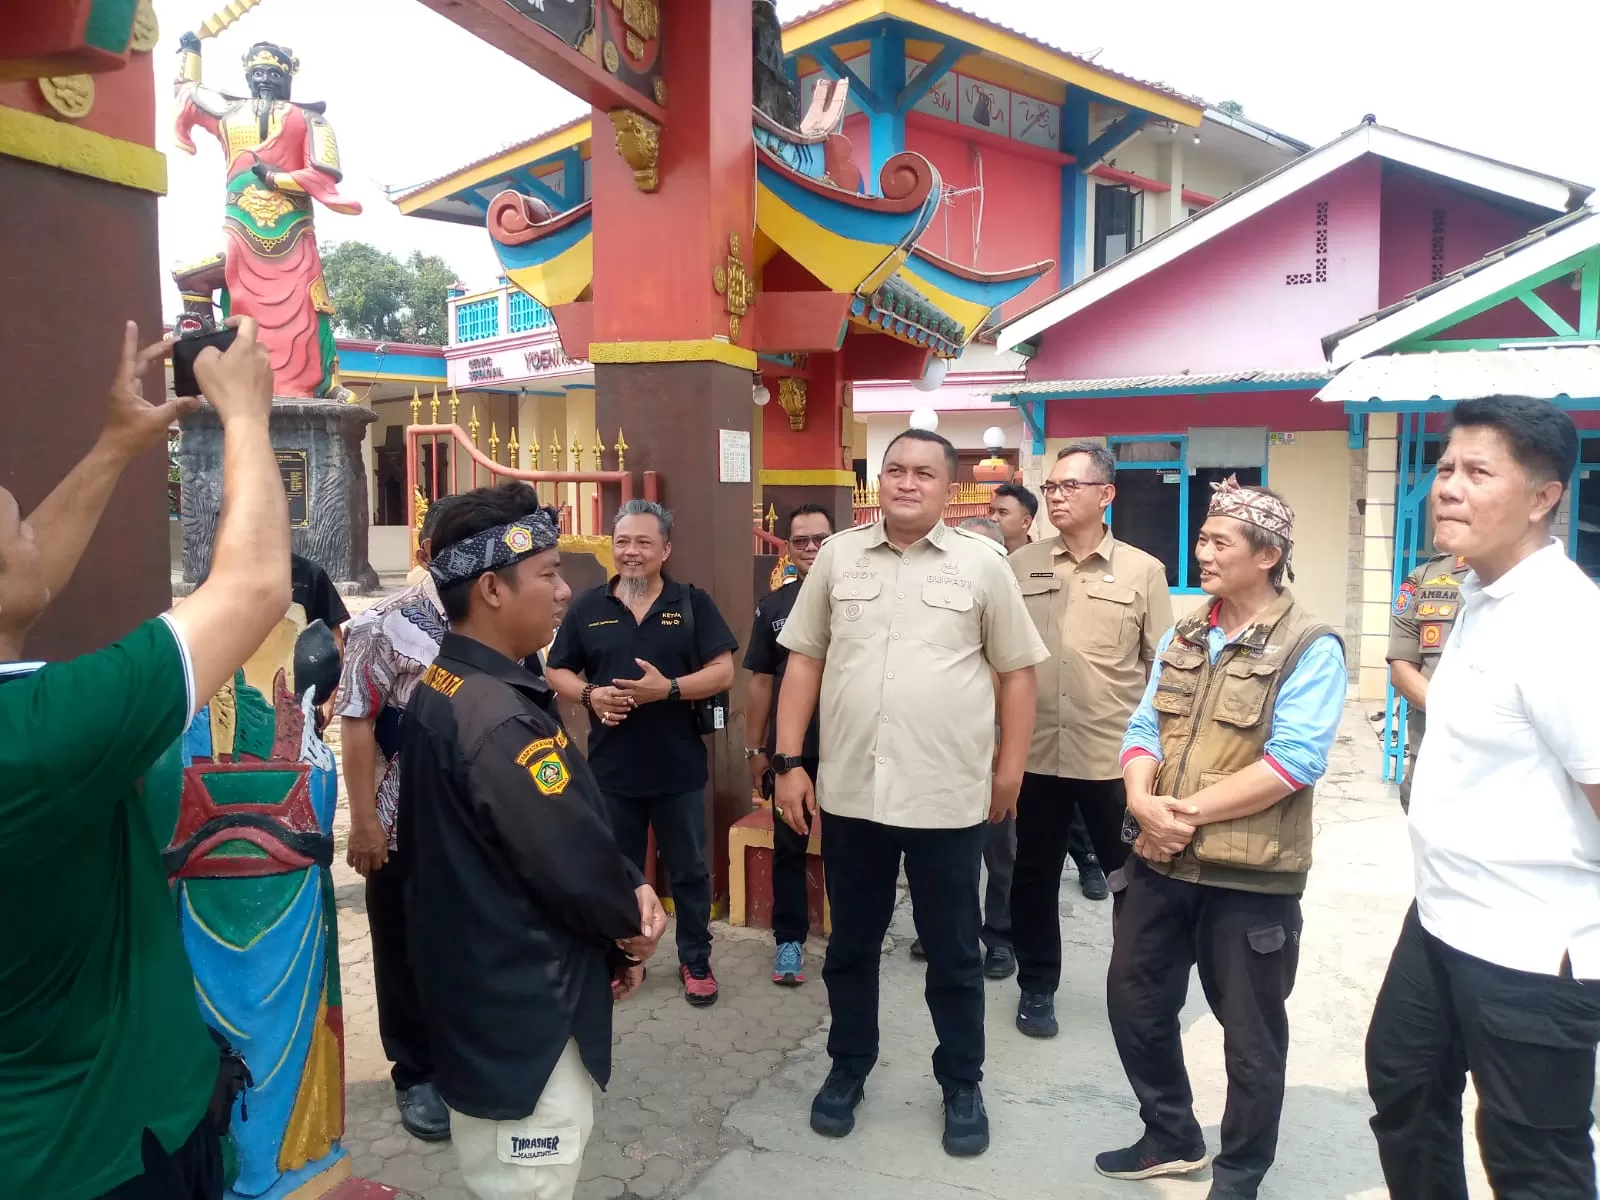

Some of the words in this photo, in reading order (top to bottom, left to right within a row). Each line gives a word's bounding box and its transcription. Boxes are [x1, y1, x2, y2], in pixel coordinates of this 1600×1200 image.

[842, 571, 878, 579] RUDY
[926, 575, 972, 588] BUPATI
[511, 1135, 560, 1153] THRASHER
